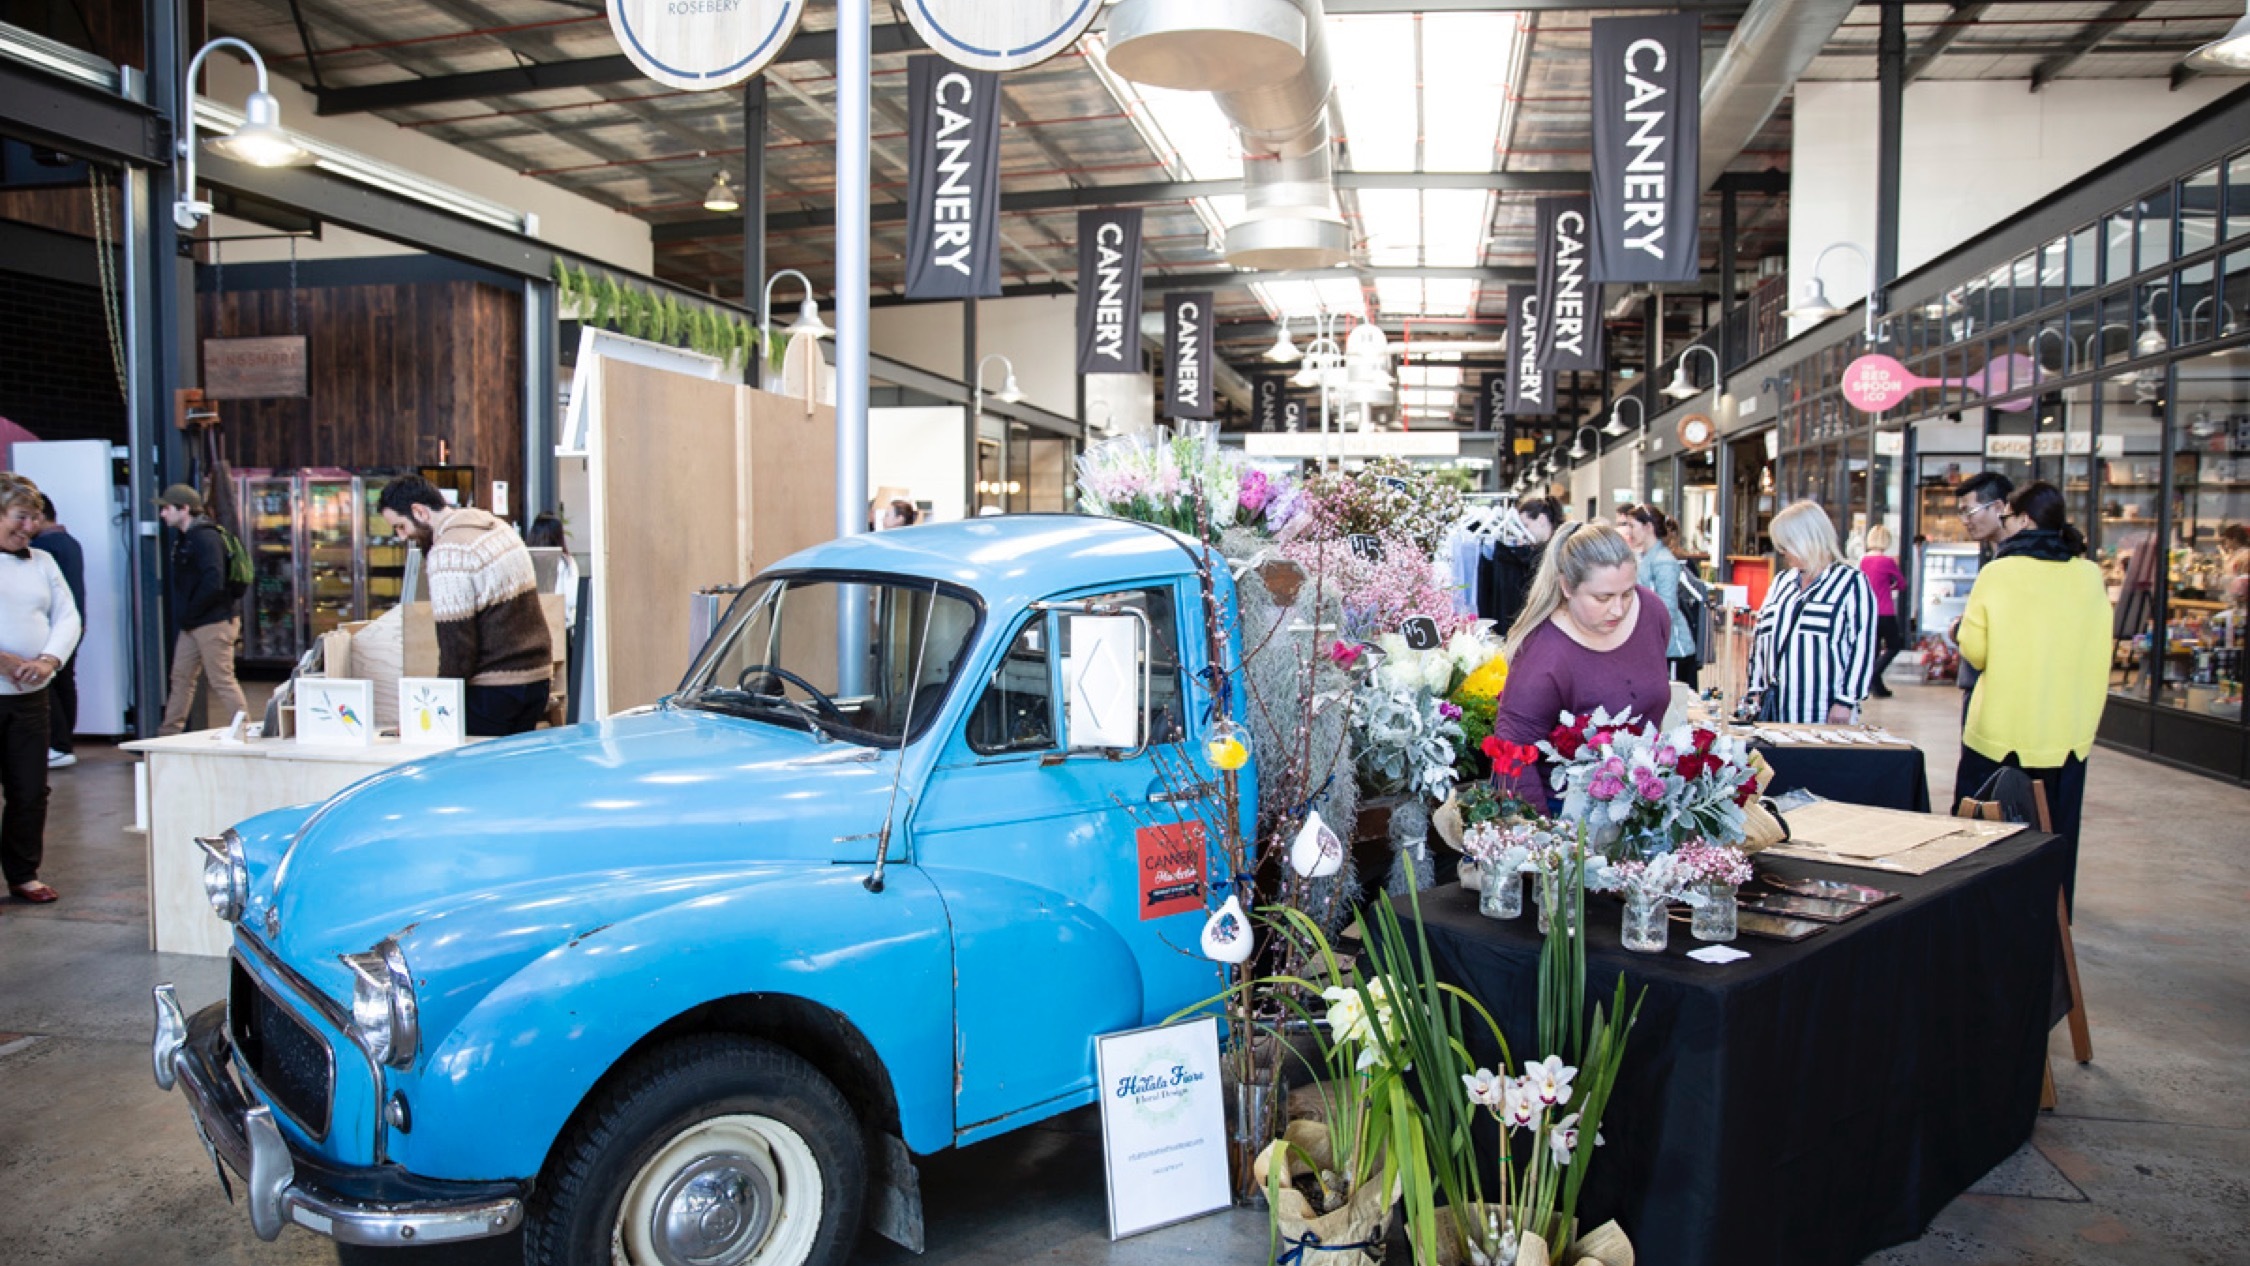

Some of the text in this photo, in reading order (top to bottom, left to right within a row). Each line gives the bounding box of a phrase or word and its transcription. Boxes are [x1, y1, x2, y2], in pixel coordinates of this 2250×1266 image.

[668, 0, 739, 15] ROSEBERY
[934, 72, 972, 277] CANNERY
[1622, 38, 1667, 260] CANNERY
[1096, 221, 1123, 362] CANNERY
[1555, 210, 1583, 358] CANNERY
[1176, 301, 1199, 409] CANNERY
[1853, 380, 1902, 392] SPOON
[1861, 370, 1889, 381] RED
